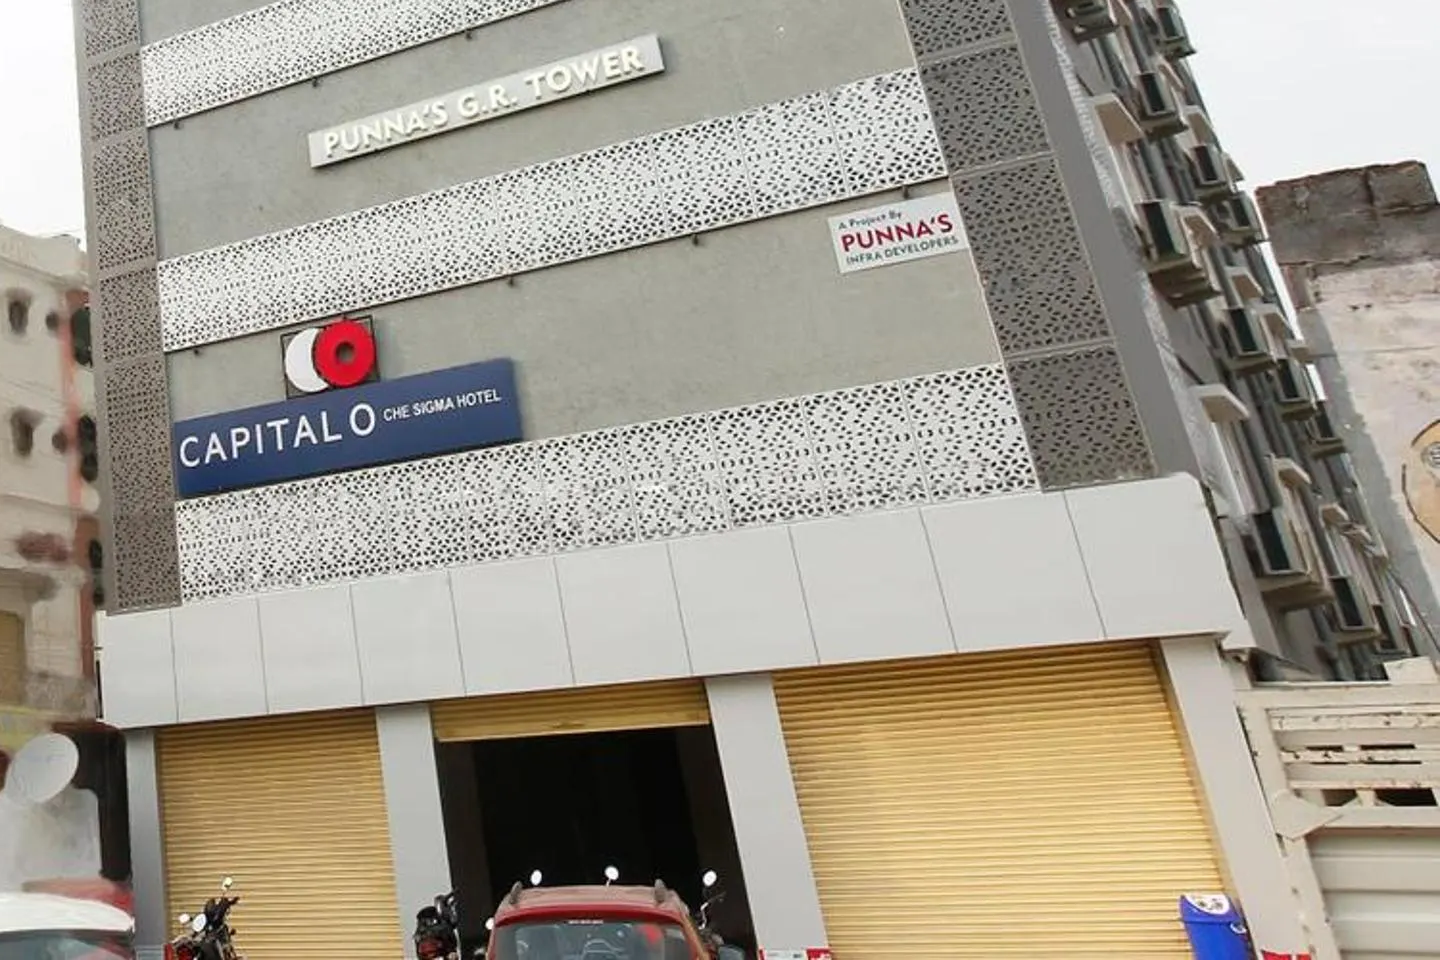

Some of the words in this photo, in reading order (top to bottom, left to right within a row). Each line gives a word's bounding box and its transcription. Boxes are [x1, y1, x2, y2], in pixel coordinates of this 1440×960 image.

[324, 98, 449, 157] PUNNA'S
[457, 82, 518, 120] G.R.
[526, 44, 646, 100] TOWER
[841, 214, 954, 252] PUNNA'S
[846, 251, 883, 265] INFRA
[884, 235, 959, 258] DEVELOPERS
[383, 405, 410, 421] CHE
[412, 397, 455, 416] SIGMA
[456, 388, 502, 408] HOTEL
[179, 411, 343, 468] CAPITAL
[349, 403, 376, 436] O
